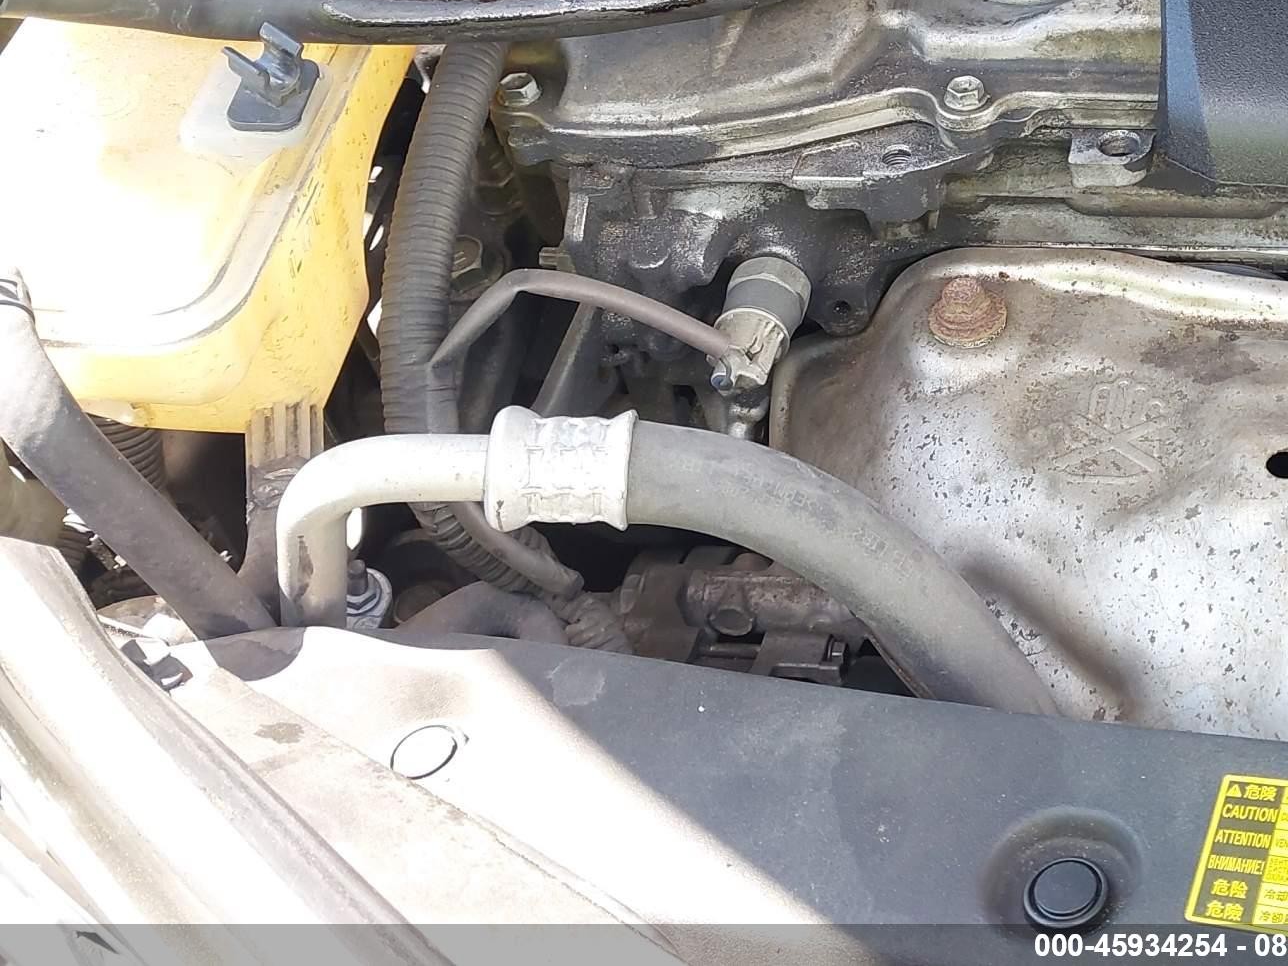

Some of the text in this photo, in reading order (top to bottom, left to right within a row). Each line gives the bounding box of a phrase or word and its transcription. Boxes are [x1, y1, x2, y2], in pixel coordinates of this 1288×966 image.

[1222, 803, 1279, 823] CAUTION
[1214, 829, 1272, 849] ATTENTION
[1208, 854, 1266, 875] ВНИМАНИЕ!
[1210, 878, 1248, 899] 危险
[1205, 900, 1244, 921] 危險
